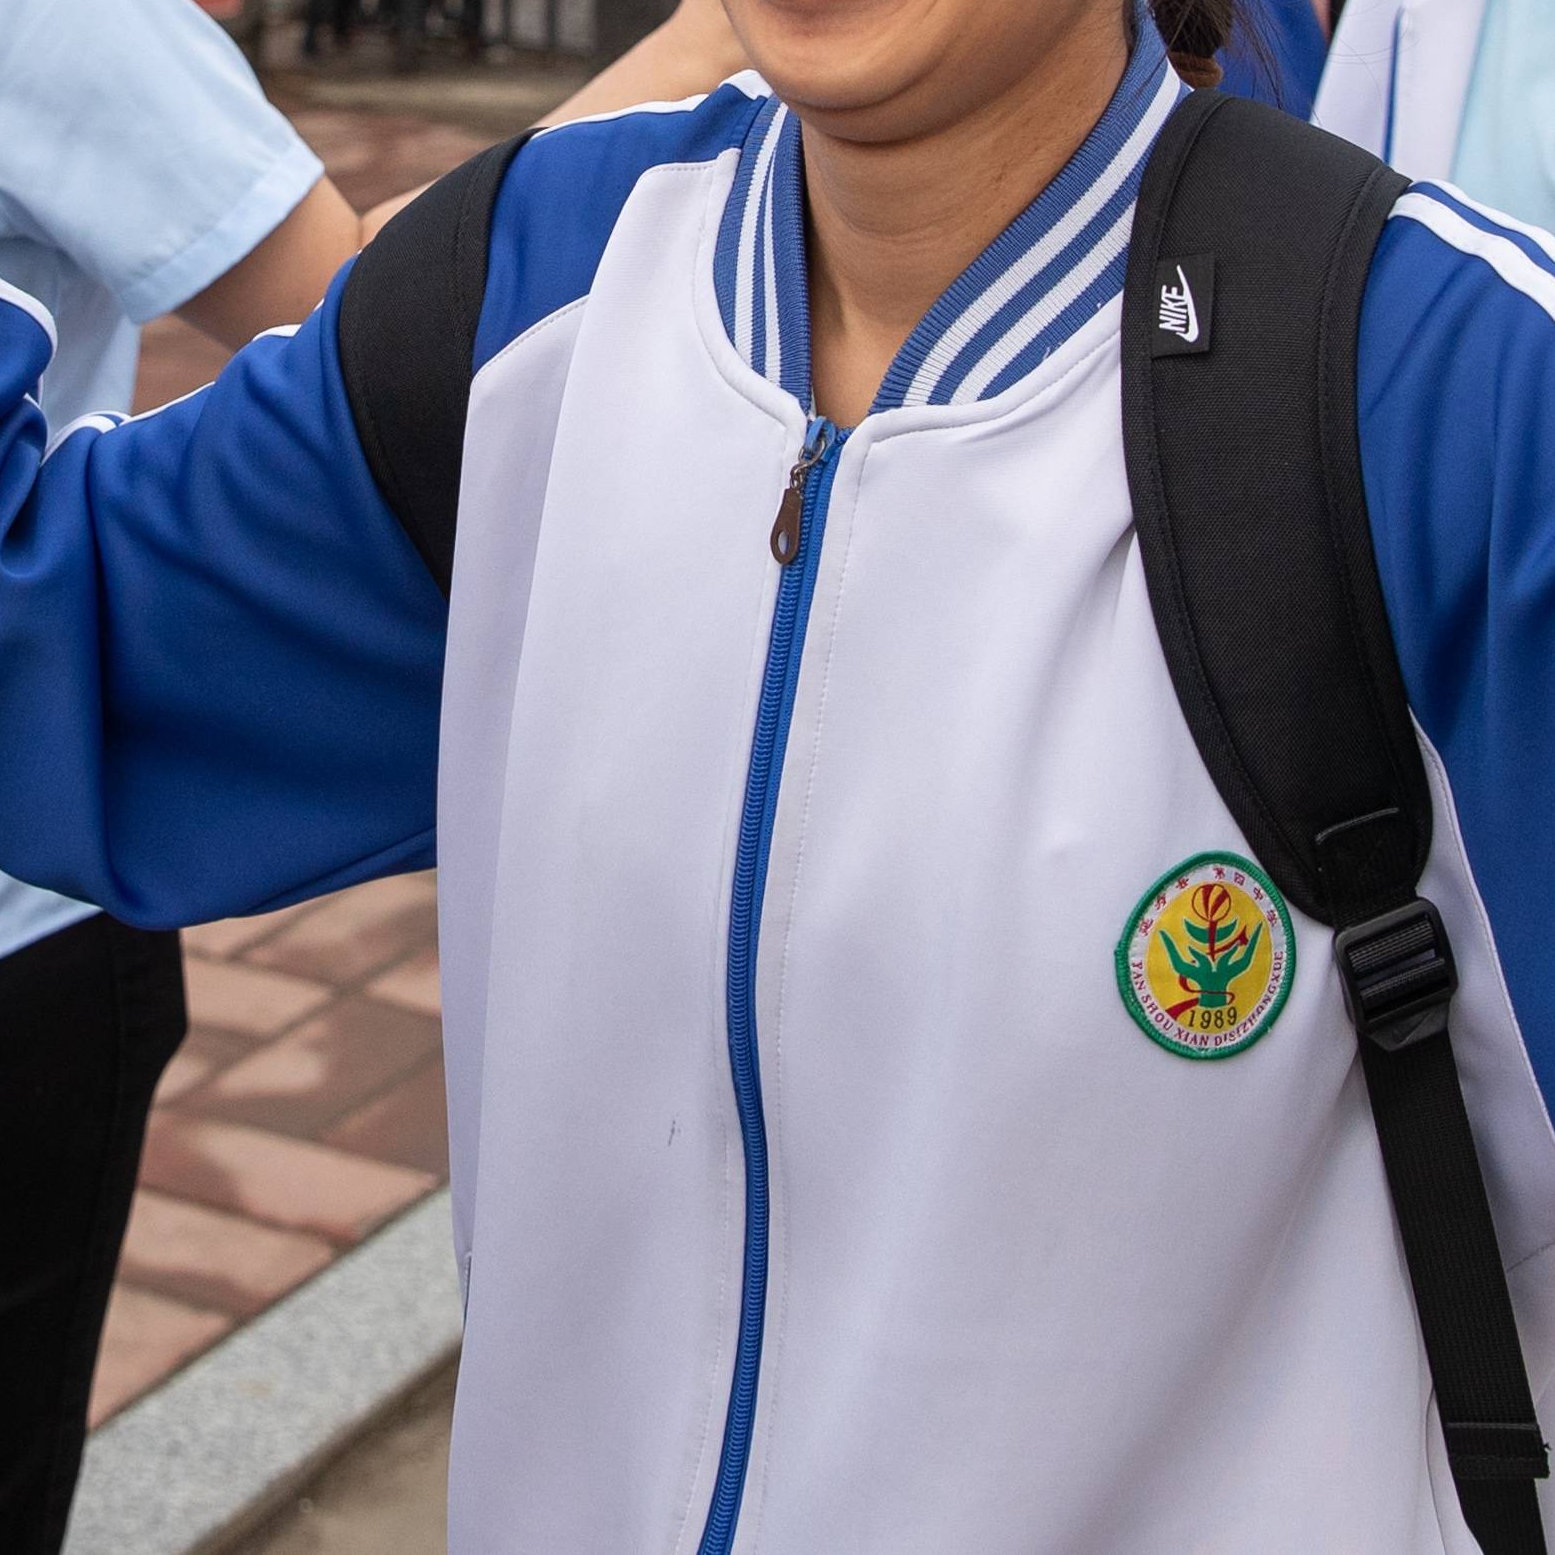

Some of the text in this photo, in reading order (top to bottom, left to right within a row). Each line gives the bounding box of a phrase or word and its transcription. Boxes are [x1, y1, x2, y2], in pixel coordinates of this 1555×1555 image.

[1158, 284, 1188, 332] NIKE
[1132, 961, 1146, 990] YAN
[1141, 994, 1174, 1031] SHOU
[1174, 1027, 1209, 1047] XIAN
[1188, 1006, 1238, 1029] 1989
